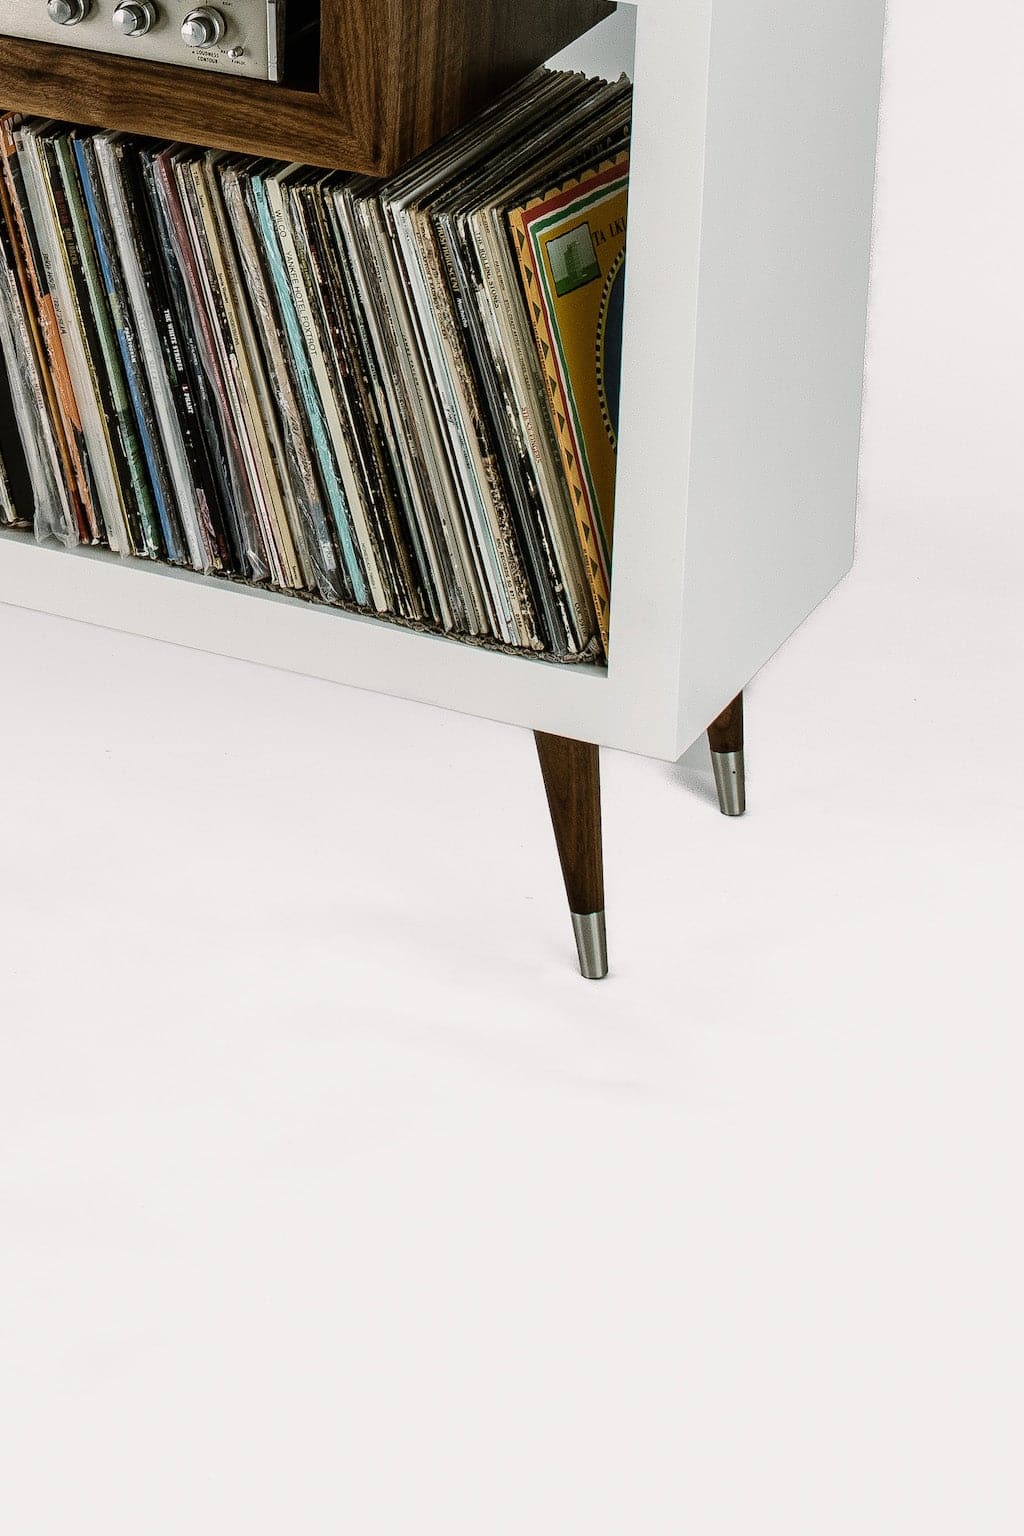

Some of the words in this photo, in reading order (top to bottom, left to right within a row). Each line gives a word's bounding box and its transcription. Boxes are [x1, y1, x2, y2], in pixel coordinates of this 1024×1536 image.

[274, 209, 287, 238] WILCO
[284, 250, 299, 284] YANKEE
[293, 285, 306, 314] HOTEL
[300, 314, 317, 358] FOXTROT
[475, 231, 483, 245] THE
[479, 247, 492, 279] ROLLING
[488, 280, 500, 309] STONES
[163, 308, 171, 322] THE
[428, 281, 440, 311] RAINBOW
[436, 311, 448, 340] CONCERT
[455, 296, 468, 328] Muchacho
[166, 322, 177, 344] WHITE
[172, 344, 183, 371] STRIPES
[528, 433, 542, 464] FINGERS
[499, 550, 510, 578] RECORDS
